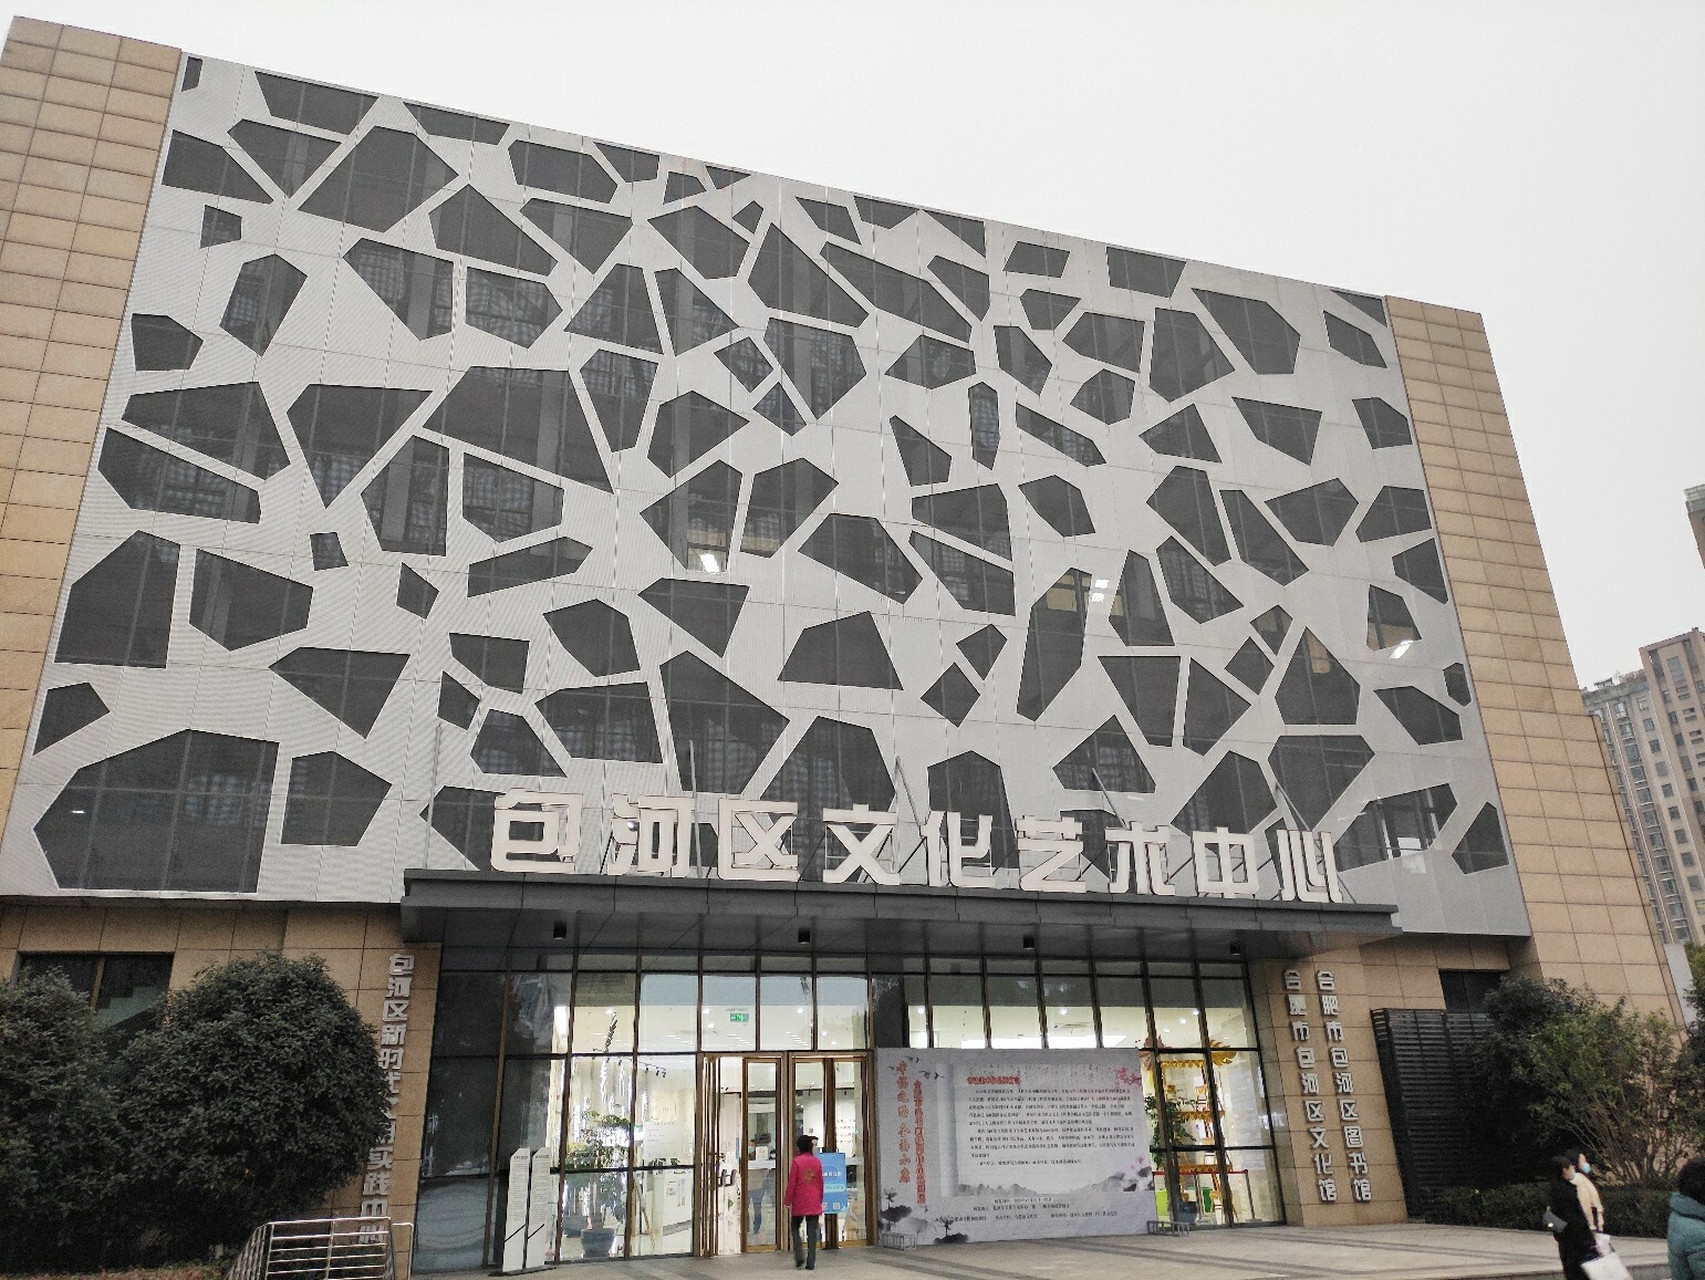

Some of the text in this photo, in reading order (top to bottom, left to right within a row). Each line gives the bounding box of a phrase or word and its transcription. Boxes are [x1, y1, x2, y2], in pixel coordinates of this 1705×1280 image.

[491, 789, 1344, 903] 包河区文化艺术中心
[1283, 968, 1338, 1202] 合肥市包河区文化馆
[1316, 969, 1373, 1202] 合肥市包河区图书馆
